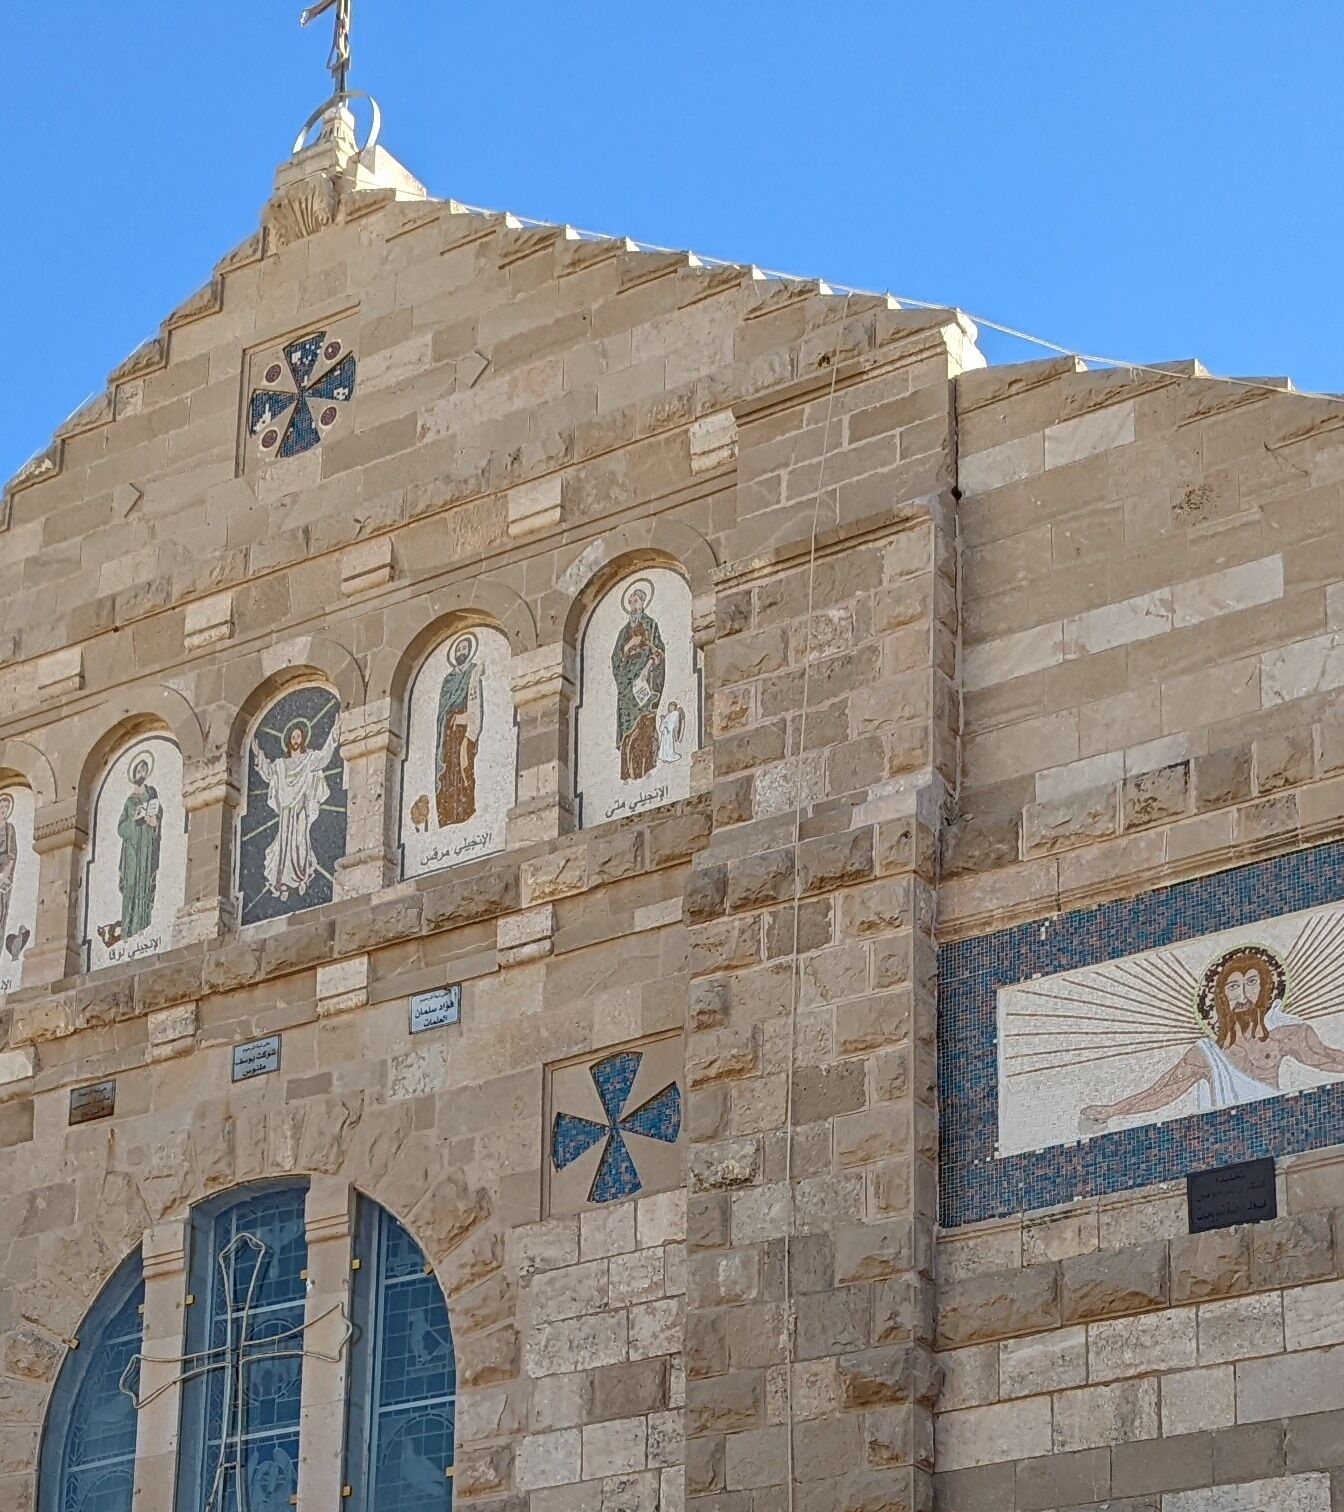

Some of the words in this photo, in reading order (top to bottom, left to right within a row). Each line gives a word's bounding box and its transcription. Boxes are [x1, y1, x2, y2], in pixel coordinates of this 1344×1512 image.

[420, 847, 450, 866] مرقس
[108, 947, 125, 961] لوقا
[415, 1006, 437, 1019] سلمان
[439, 1000, 455, 1012] فؤاد
